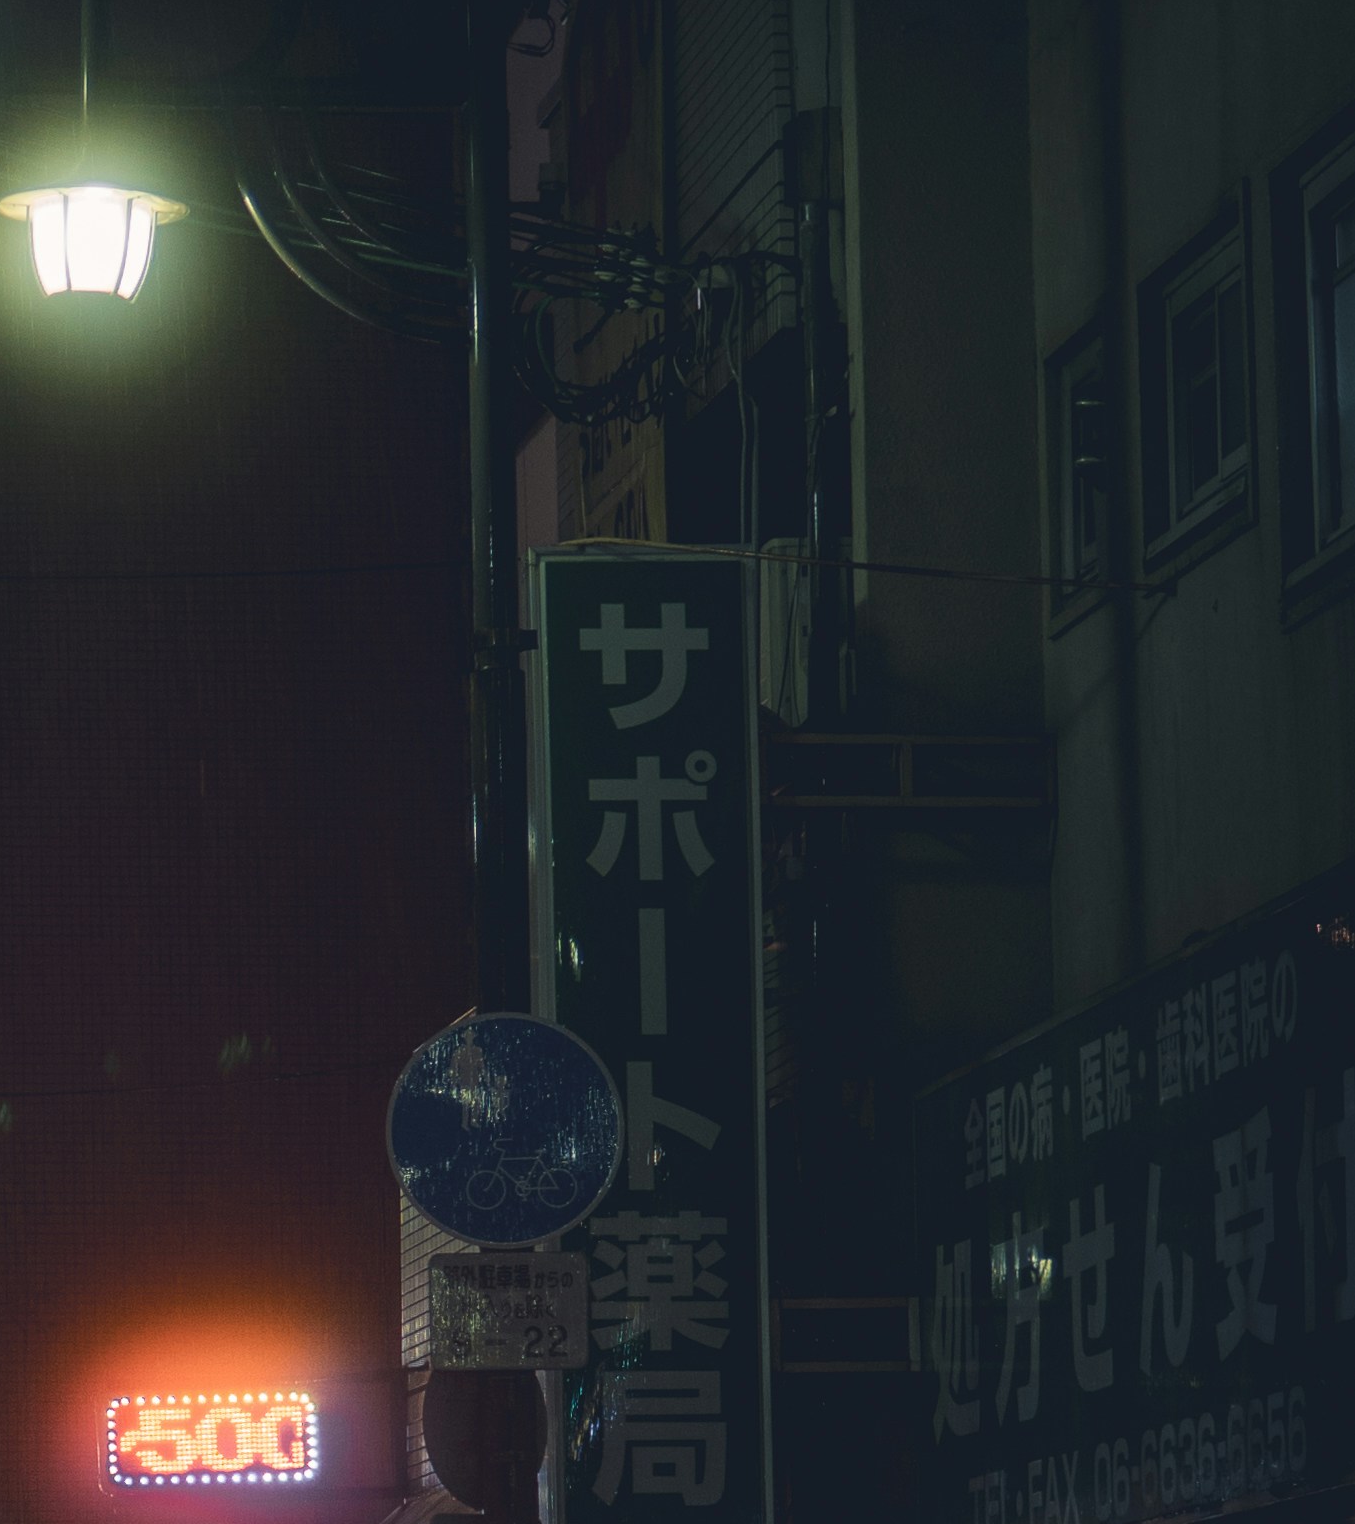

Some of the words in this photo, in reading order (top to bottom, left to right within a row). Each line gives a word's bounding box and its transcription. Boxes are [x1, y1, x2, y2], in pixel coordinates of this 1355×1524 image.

[579, 602, 730, 1507] サポート薬局
[932, 1066, 1355, 1446] 処方せん受付
